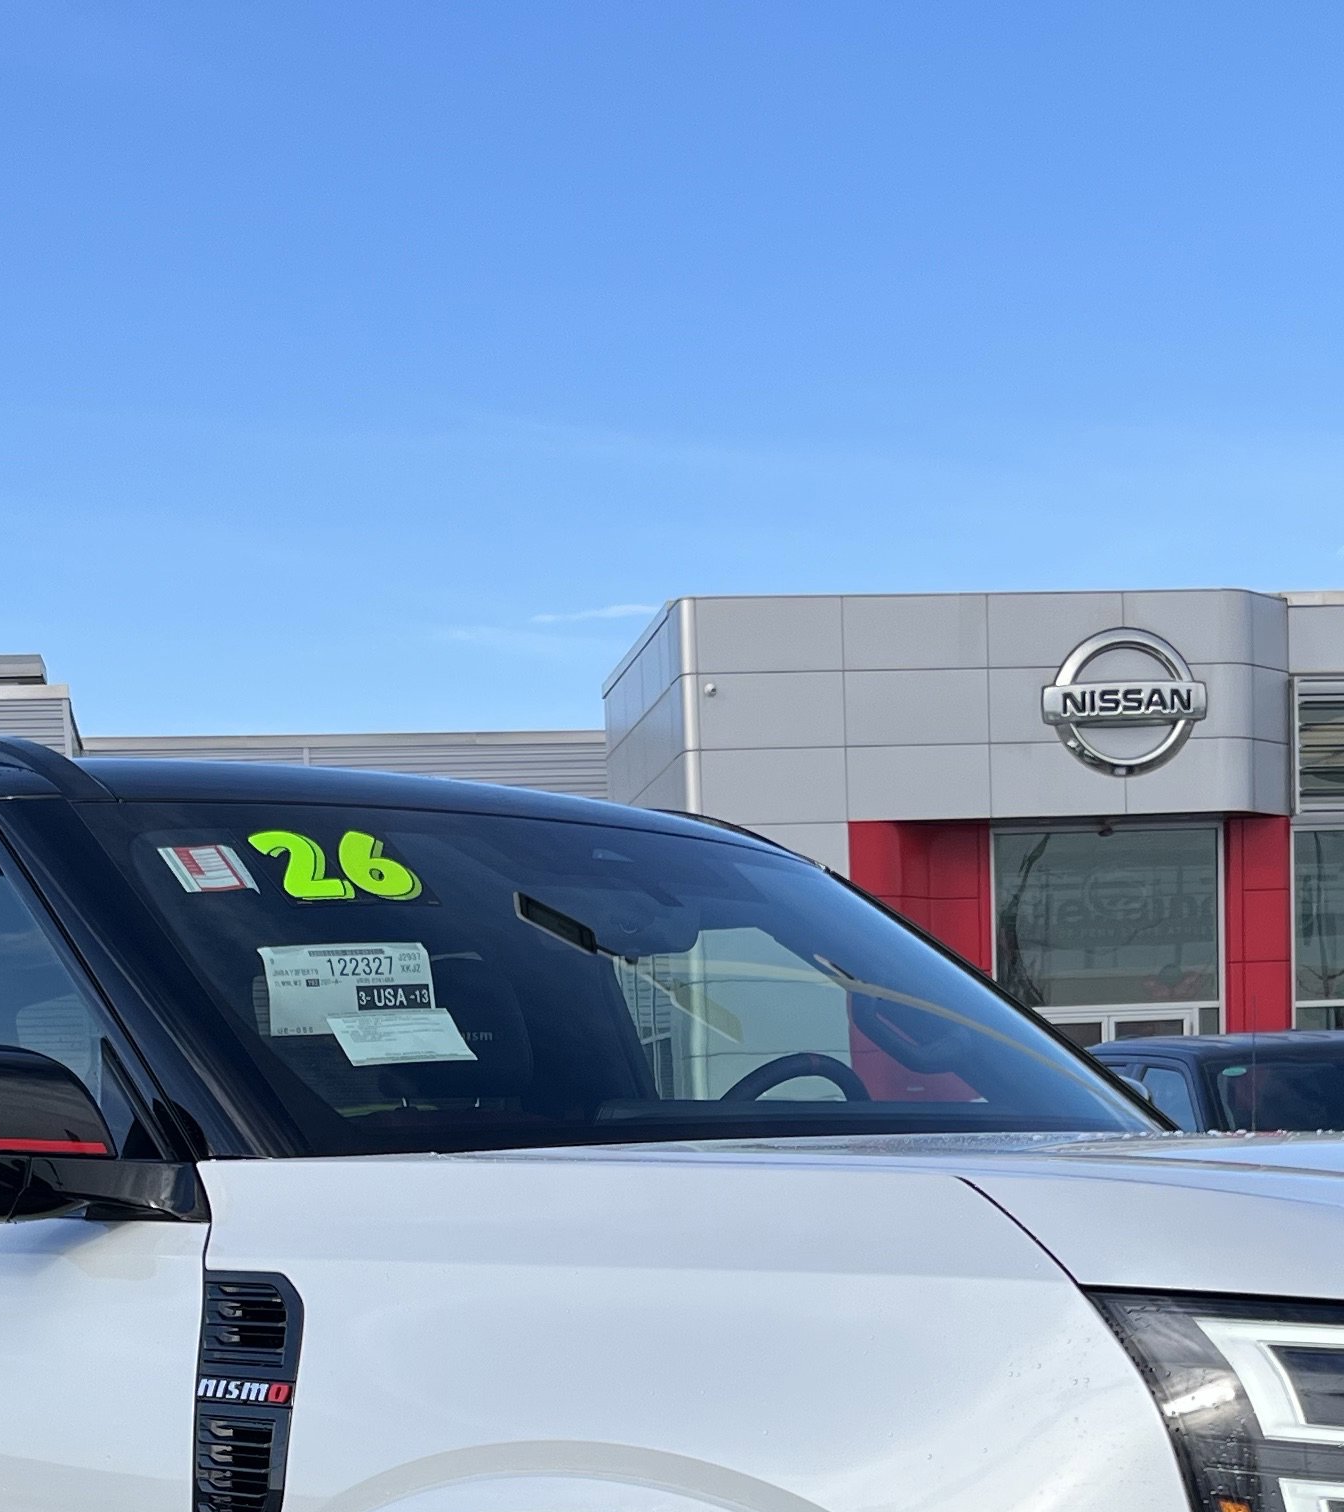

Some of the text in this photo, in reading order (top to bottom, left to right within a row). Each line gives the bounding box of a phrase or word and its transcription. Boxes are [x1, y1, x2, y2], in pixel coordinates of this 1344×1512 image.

[1061, 687, 1193, 716] NISSAN
[248, 830, 423, 900] 26
[326, 956, 393, 977] 122327
[373, 987, 408, 1007] USA
